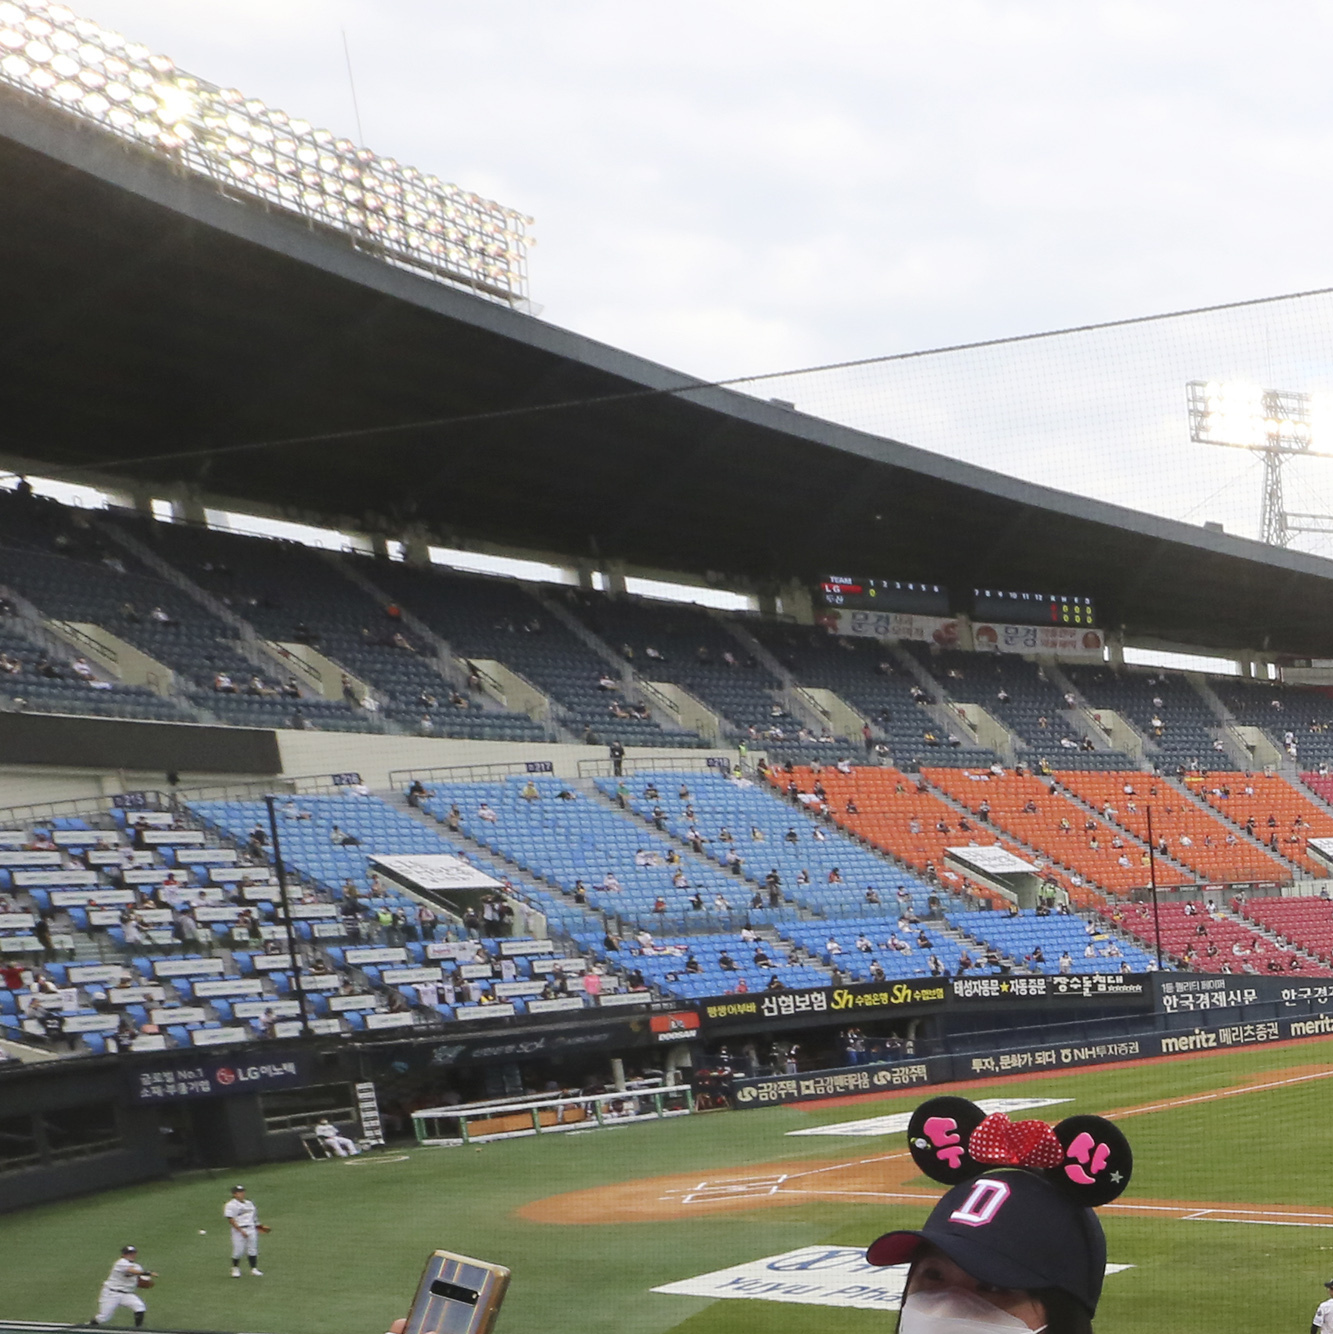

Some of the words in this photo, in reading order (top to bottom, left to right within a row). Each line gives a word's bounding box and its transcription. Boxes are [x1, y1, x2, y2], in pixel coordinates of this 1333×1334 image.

[830, 576, 853, 585] TEAM
[760, 990, 829, 1018] 신협보험
[830, 987, 854, 1011] Sh
[889, 983, 912, 1004] Sh
[1162, 988, 1259, 1013] 한국경제신문
[1160, 1028, 1218, 1053] meritz
[1218, 1021, 1280, 1046] 메리츠증권
[999, 1053, 1033, 1071] 문화가
[1034, 1050, 1057, 1066] 되다
[1073, 1041, 1140, 1061] NH투자증권
[756, 1079, 798, 1101] 금강주택
[890, 1063, 928, 1085] 금강주택
[948, 1178, 1012, 1228] D
[714, 1275, 819, 1295] Yuyu
